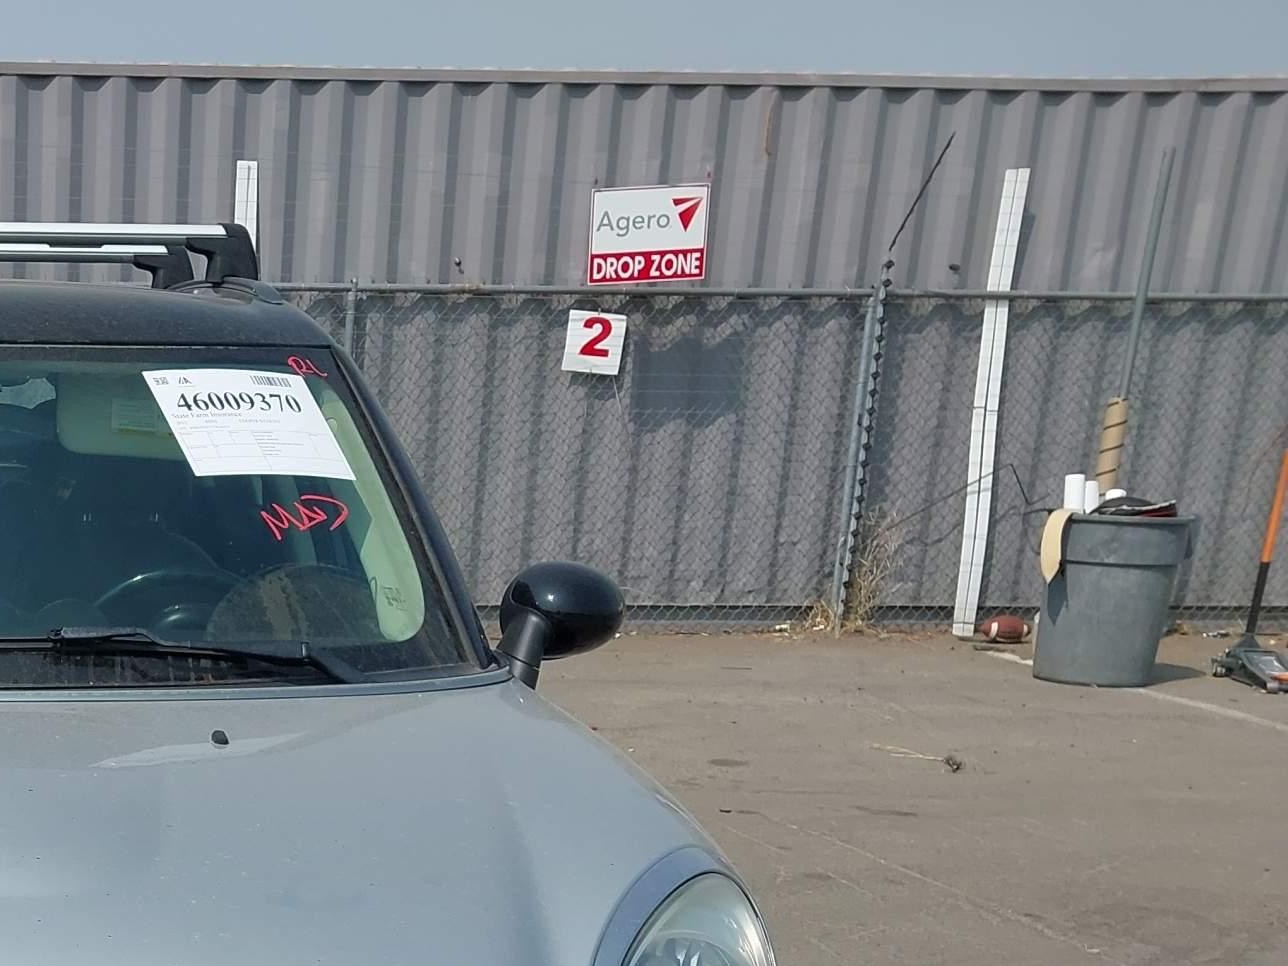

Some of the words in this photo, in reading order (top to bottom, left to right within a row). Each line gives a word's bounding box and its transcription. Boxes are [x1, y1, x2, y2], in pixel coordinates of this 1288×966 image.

[596, 210, 671, 238] Agero
[592, 255, 645, 280] DROP
[649, 252, 702, 277] ZONE
[578, 316, 613, 358] 2
[177, 391, 302, 413] 46009370
